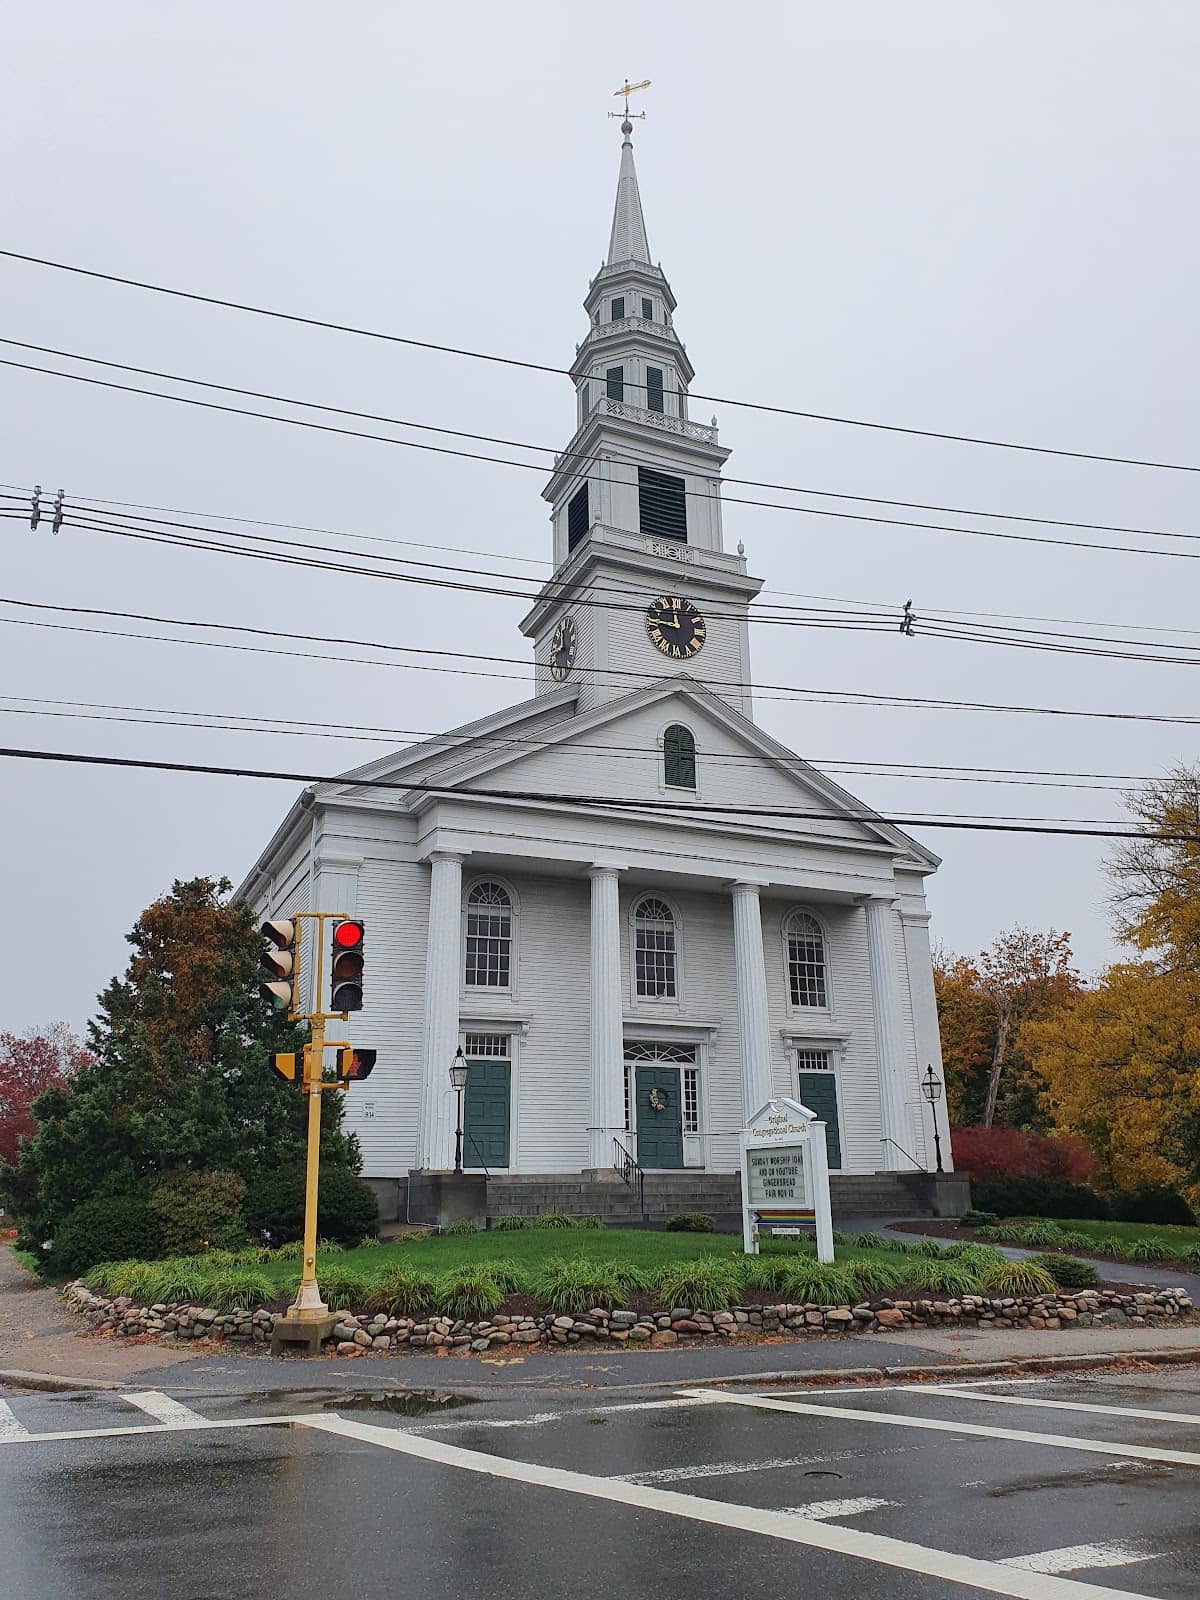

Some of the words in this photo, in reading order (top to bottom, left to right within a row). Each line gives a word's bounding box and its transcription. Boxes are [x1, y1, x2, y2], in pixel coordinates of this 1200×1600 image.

[768, 1113, 788, 1125] Original
[753, 1125, 787, 1137] Congregational
[788, 1123, 806, 1133] Church
[752, 1156, 768, 1166] SUNDAY
[770, 1155, 790, 1165] WORSHIP
[759, 1167, 767, 1176] AND
[769, 1167, 775, 1176] ON
[776, 1166, 798, 1176] YOUTUBE
[762, 1177, 796, 1187] GINGERBREAD
[765, 1189, 776, 1198] FAIR
[777, 1189, 787, 1198] NOV
